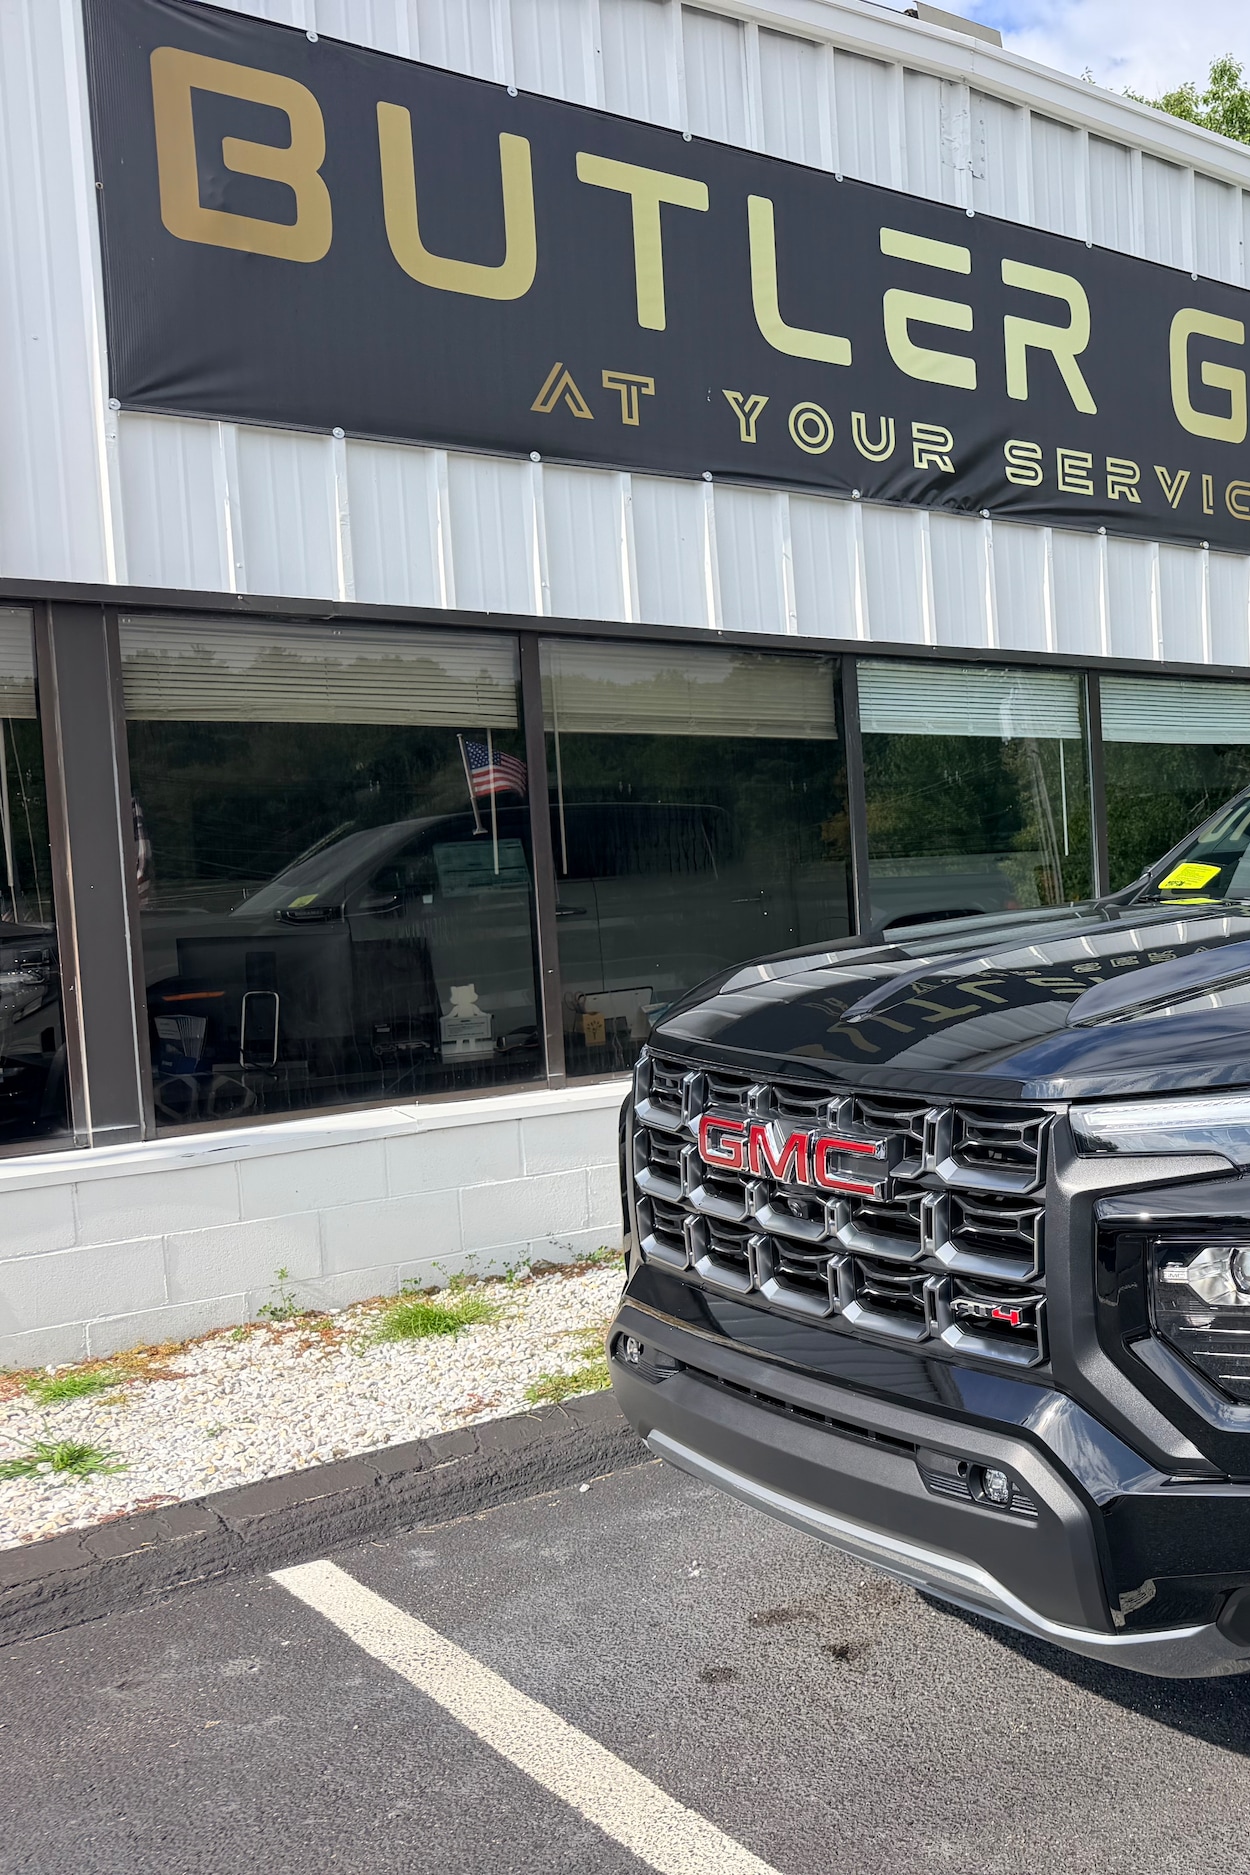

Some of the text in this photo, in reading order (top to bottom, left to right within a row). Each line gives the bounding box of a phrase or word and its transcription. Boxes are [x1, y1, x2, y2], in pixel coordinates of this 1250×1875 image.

[150, 46, 1098, 415] BUTLER
[530, 361, 655, 427] AT
[722, 387, 956, 474] YOUR
[698, 1114, 884, 1199] GMC
[950, 1299, 1020, 1327] AT4
